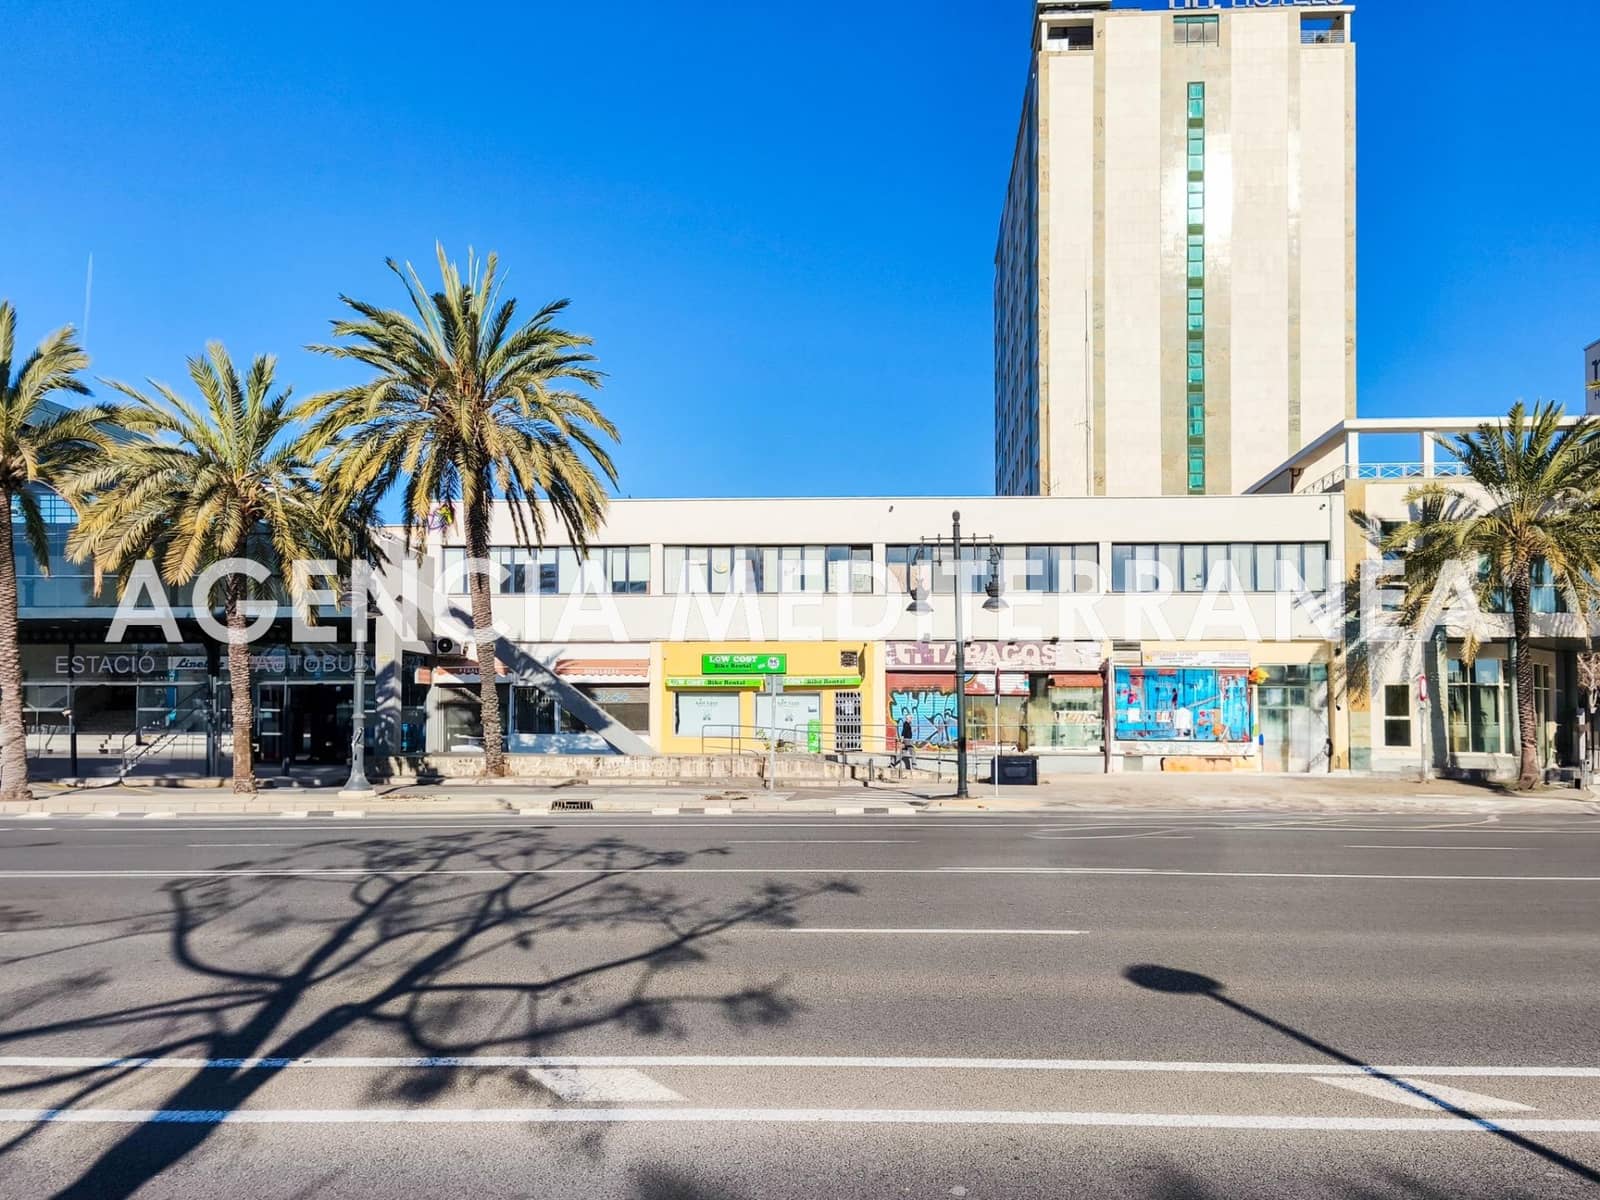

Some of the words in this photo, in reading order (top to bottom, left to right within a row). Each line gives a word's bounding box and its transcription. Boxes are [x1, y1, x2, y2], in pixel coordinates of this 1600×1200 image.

[55, 651, 156, 674] ESTACIÓ
[709, 655, 730, 663] LOW
[733, 655, 758, 663] COST
